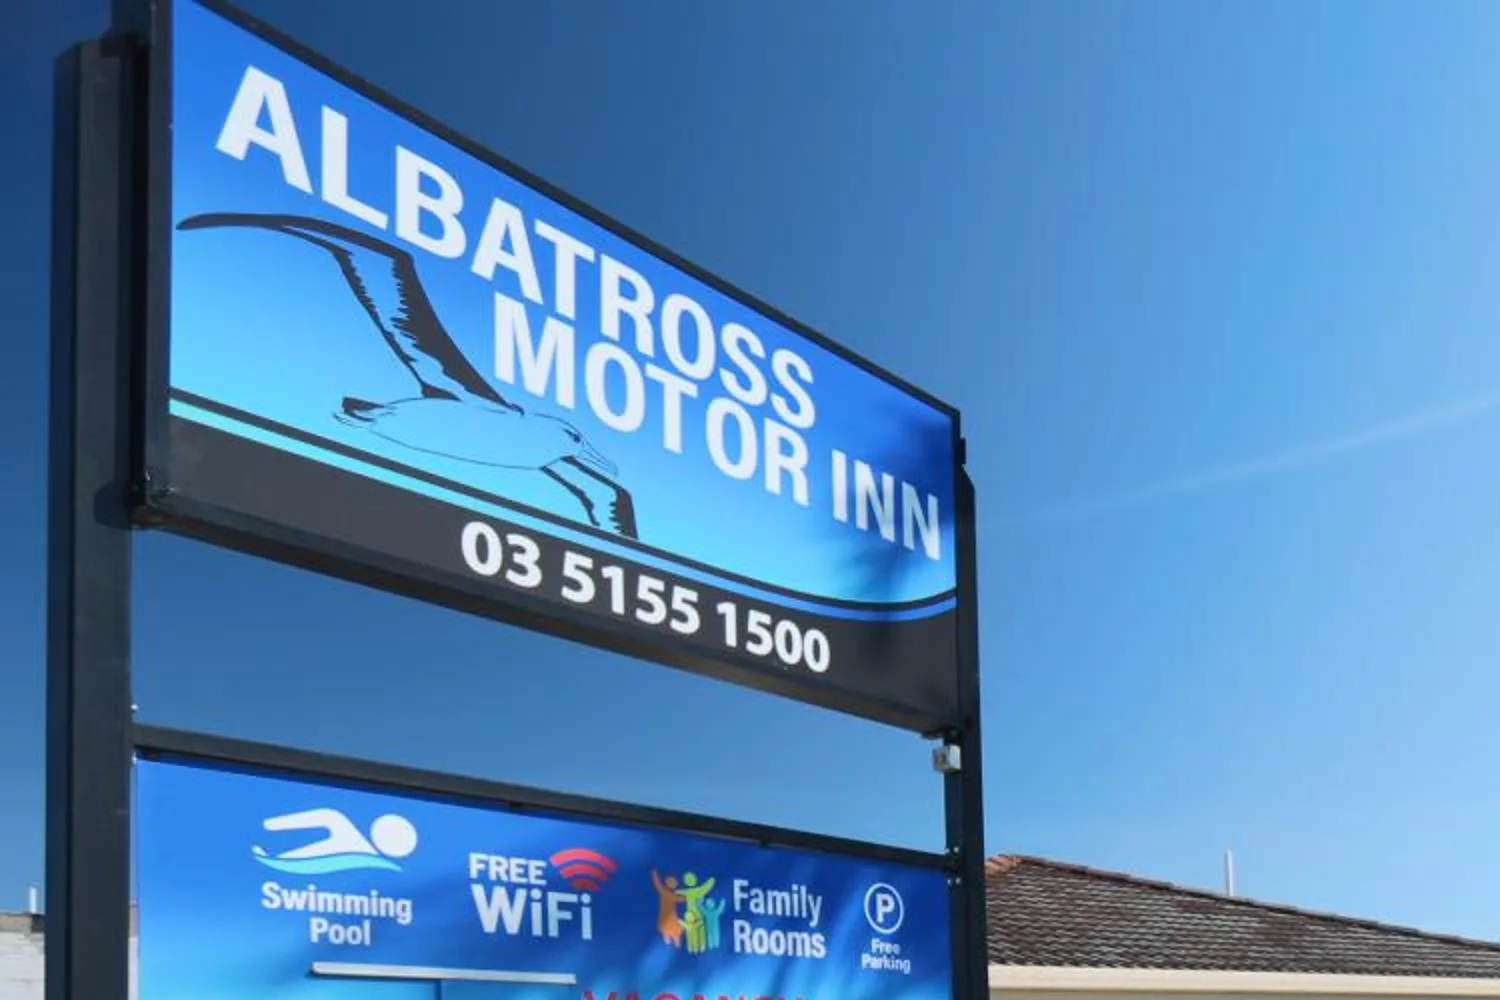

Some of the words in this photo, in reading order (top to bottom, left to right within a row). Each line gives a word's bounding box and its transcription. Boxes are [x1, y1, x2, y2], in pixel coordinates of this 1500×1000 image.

[215, 65, 815, 429] ALBATROSS
[494, 291, 809, 506] MOTOR
[832, 450, 941, 560] INN
[461, 522, 543, 588] 03
[561, 552, 700, 635] 5155
[718, 602, 831, 673] 1500
[469, 854, 547, 884] FREE
[262, 882, 412, 924] Swimming
[471, 885, 593, 940] WiFi
[733, 880, 822, 926] Family
[876, 894, 896, 923] P
[309, 917, 371, 946] Pool
[733, 920, 826, 958] Rooms
[871, 939, 901, 955] Free
[861, 954, 911, 974] Parking
